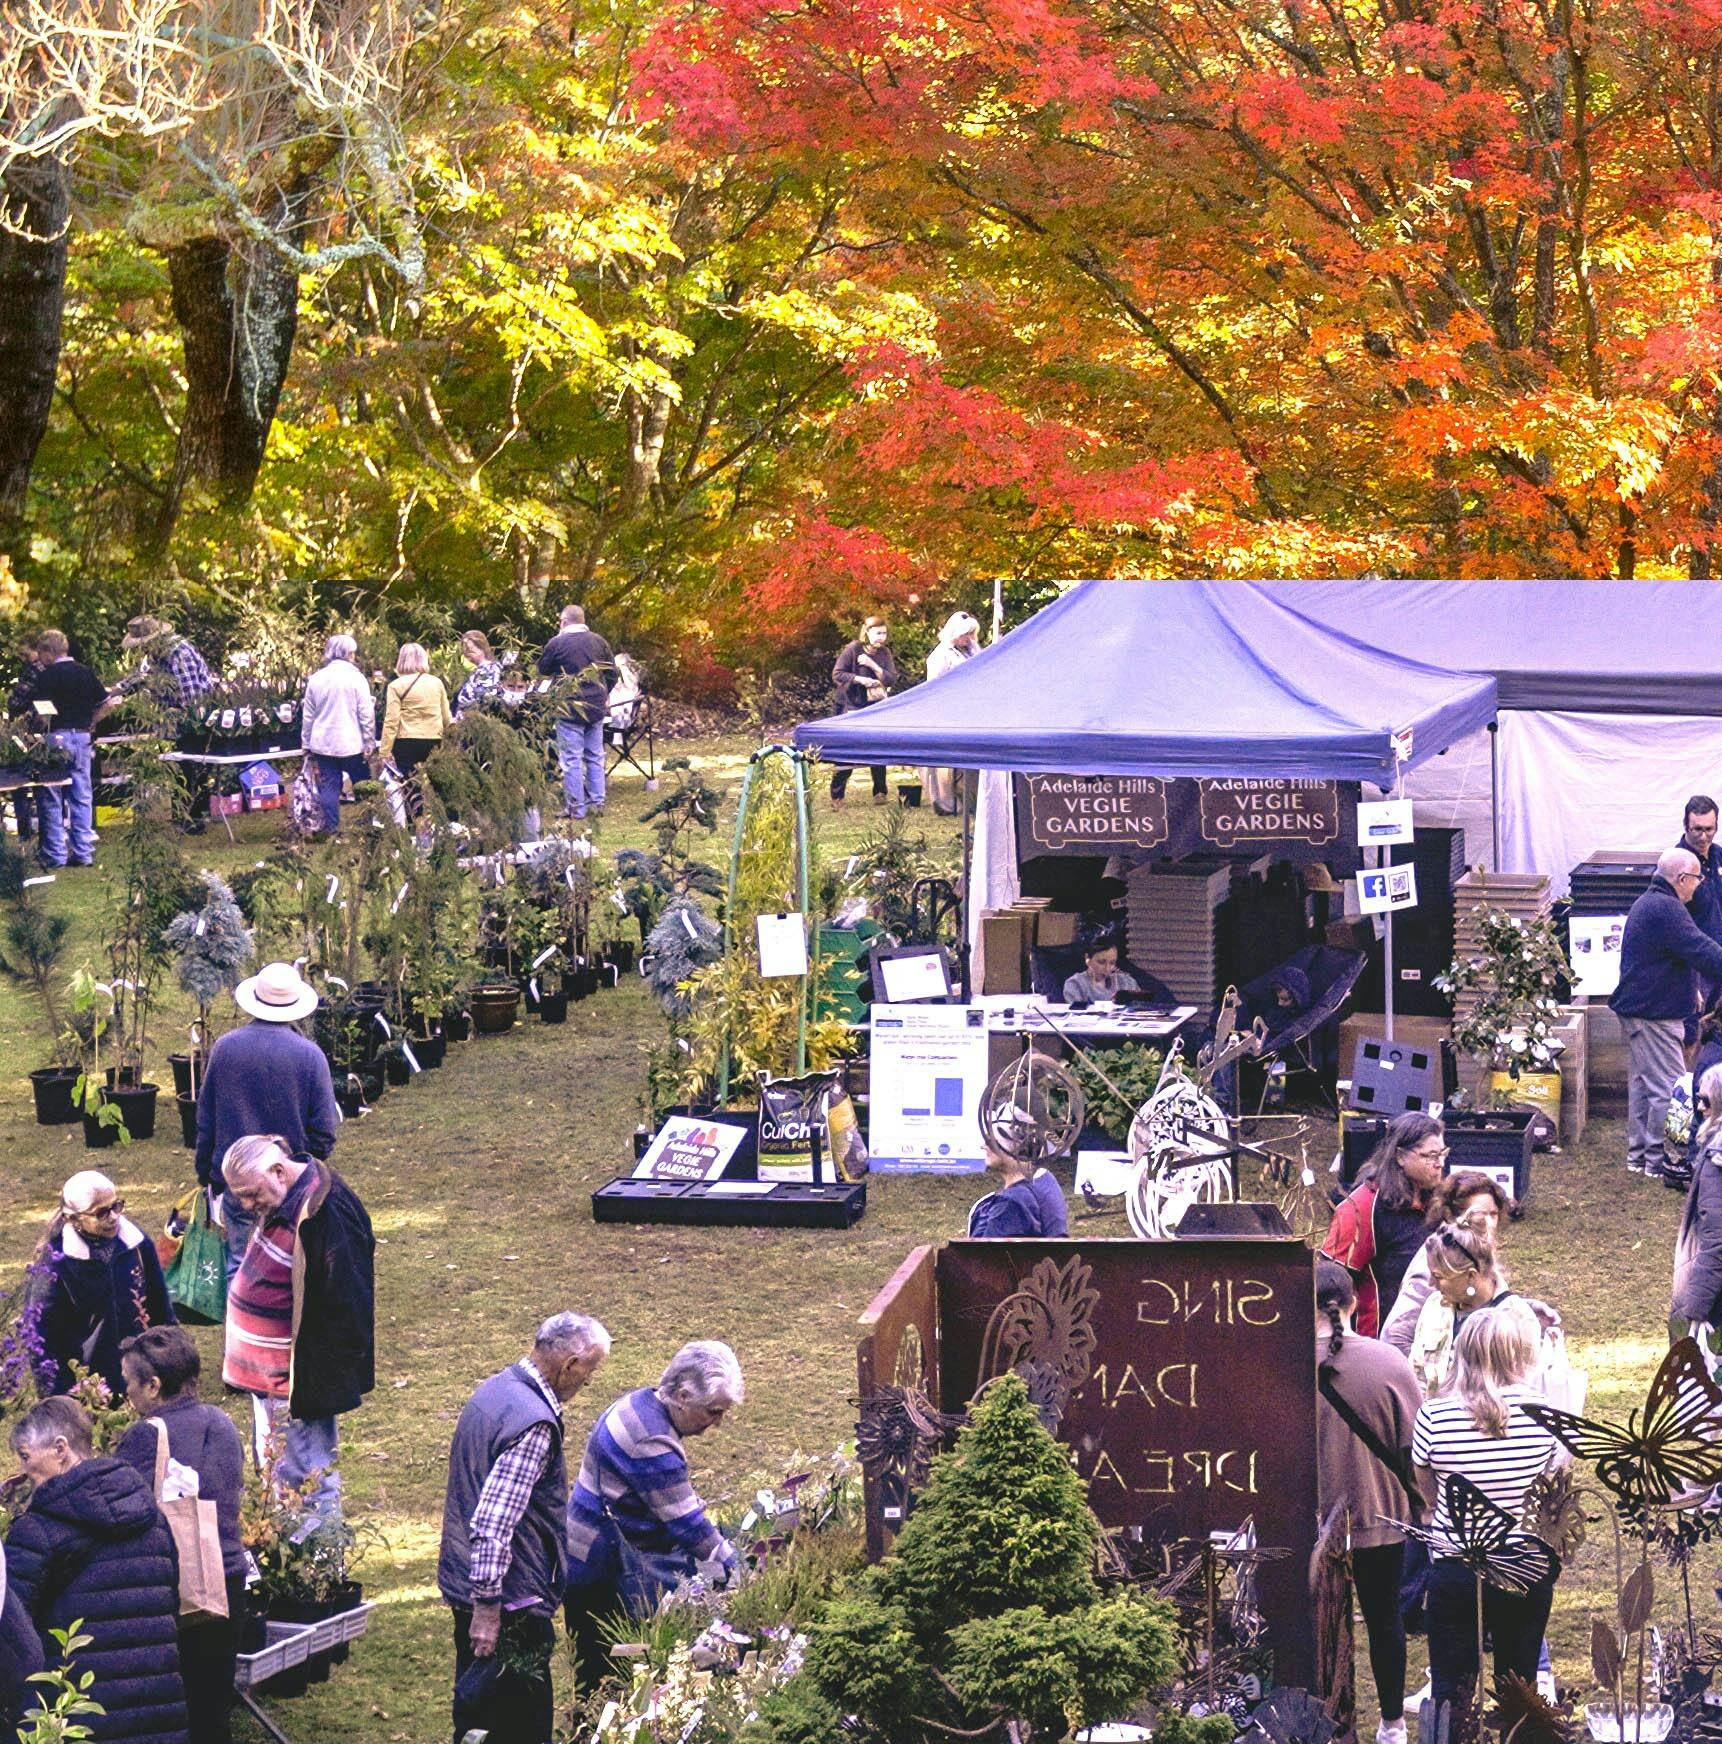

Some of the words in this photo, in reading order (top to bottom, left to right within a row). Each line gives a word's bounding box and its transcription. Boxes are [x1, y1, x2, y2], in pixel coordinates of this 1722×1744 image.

[1040, 779, 1113, 793] Adelaide
[1118, 778, 1156, 794] Hills
[1208, 778, 1286, 791] Adelaide
[1064, 797, 1132, 813] VEGIE
[1234, 793, 1304, 811] VEGIE
[1046, 816, 1154, 833] GARDENS
[1215, 812, 1325, 831] GARDENS
[671, 1152, 702, 1167] VEGIE
[656, 1161, 704, 1179] GARDENS
